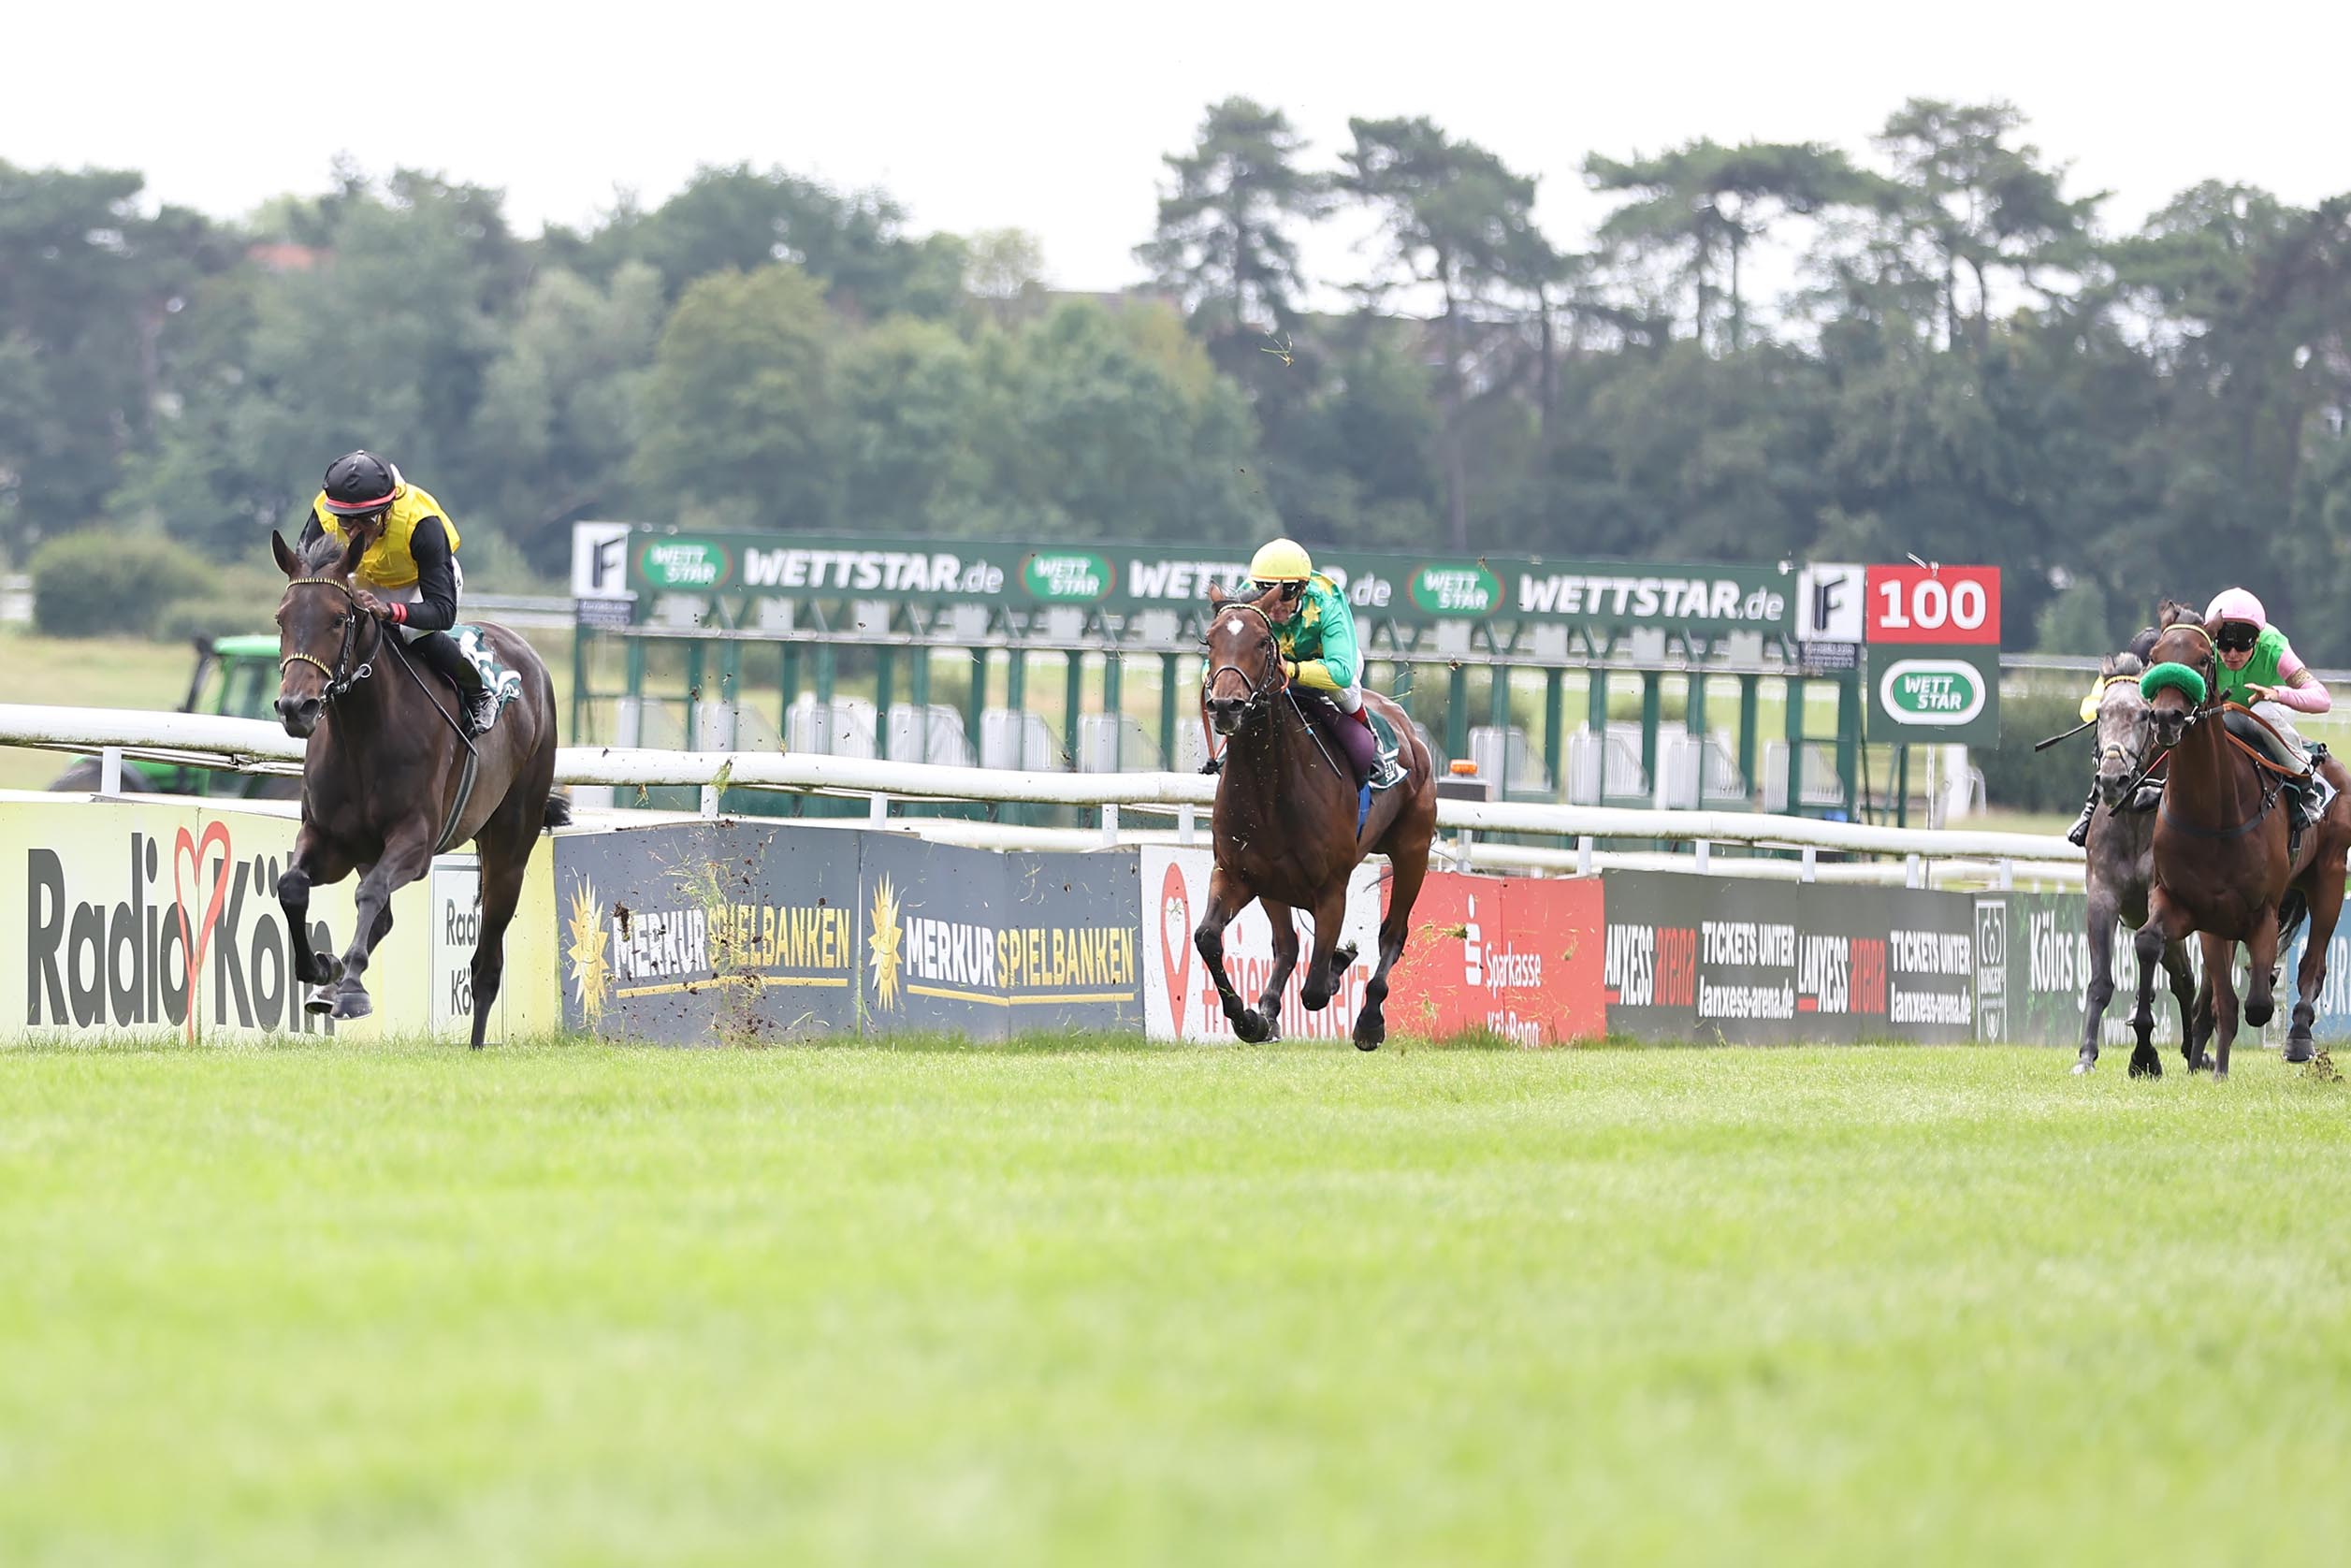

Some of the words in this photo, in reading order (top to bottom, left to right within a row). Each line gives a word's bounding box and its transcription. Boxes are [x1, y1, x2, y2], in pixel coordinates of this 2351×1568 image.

[651, 544, 708, 565] WETT
[665, 562, 717, 585] STAR
[744, 547, 1004, 594] WETTSTAR.de
[1034, 556, 1091, 577] WETT
[1048, 573, 1100, 597] STAR
[1424, 569, 1481, 591] WETT
[1437, 588, 1489, 611] STAR
[1519, 573, 1785, 621] WETTSTAR.de
[1879, 578, 1987, 631] 100
[1904, 675, 1954, 694] WETT
[1917, 691, 1962, 710] STAR
[27, 832, 188, 1028] Radio
[1702, 921, 1757, 966] TICKETS
[1759, 922, 1795, 966] UNTER
[1891, 929, 1939, 974] TICKETS
[1939, 933, 1971, 976] UNTER
[2030, 909, 2073, 993] Kölns
[1485, 940, 1542, 999] Sparkasse
[1604, 923, 1654, 1007] ANXESS
[1655, 927, 1696, 1007] arena
[1798, 934, 1850, 1014] LANXESS
[1850, 937, 1886, 1014] arena
[1698, 974, 1795, 1019] lanxess-arena.de
[1891, 981, 1972, 1025] lanxess-arena.de
